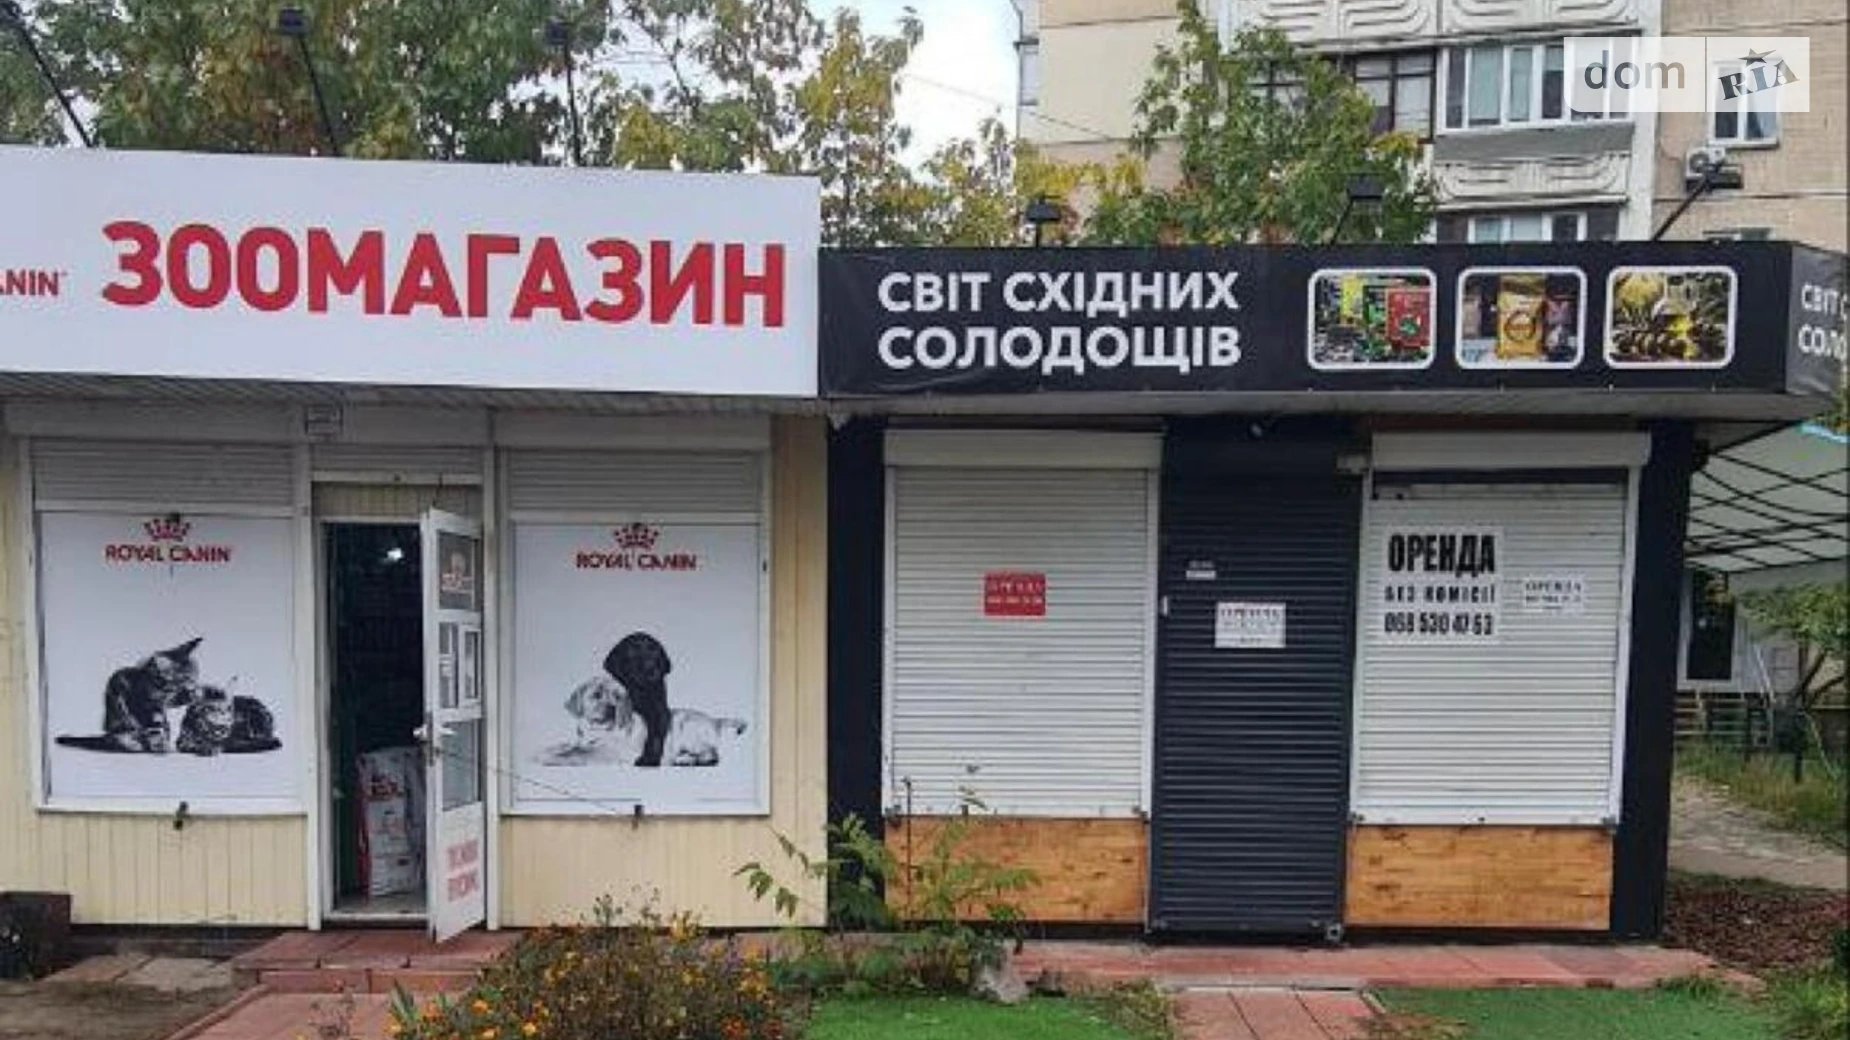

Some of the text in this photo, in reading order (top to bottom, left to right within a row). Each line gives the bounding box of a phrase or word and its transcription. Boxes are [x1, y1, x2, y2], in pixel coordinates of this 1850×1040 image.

[0, 268, 59, 296] NIN
[101, 220, 785, 328] ЗООМАГАЗИН
[878, 271, 1240, 318] СВІТ СХІДНИХ
[878, 326, 1242, 375] СОЛОДОЩІВ
[105, 543, 230, 563] ROYAL CANIN
[576, 551, 697, 571] ROYAL CANIN
[1387, 534, 1496, 578] ОРЕНДА
